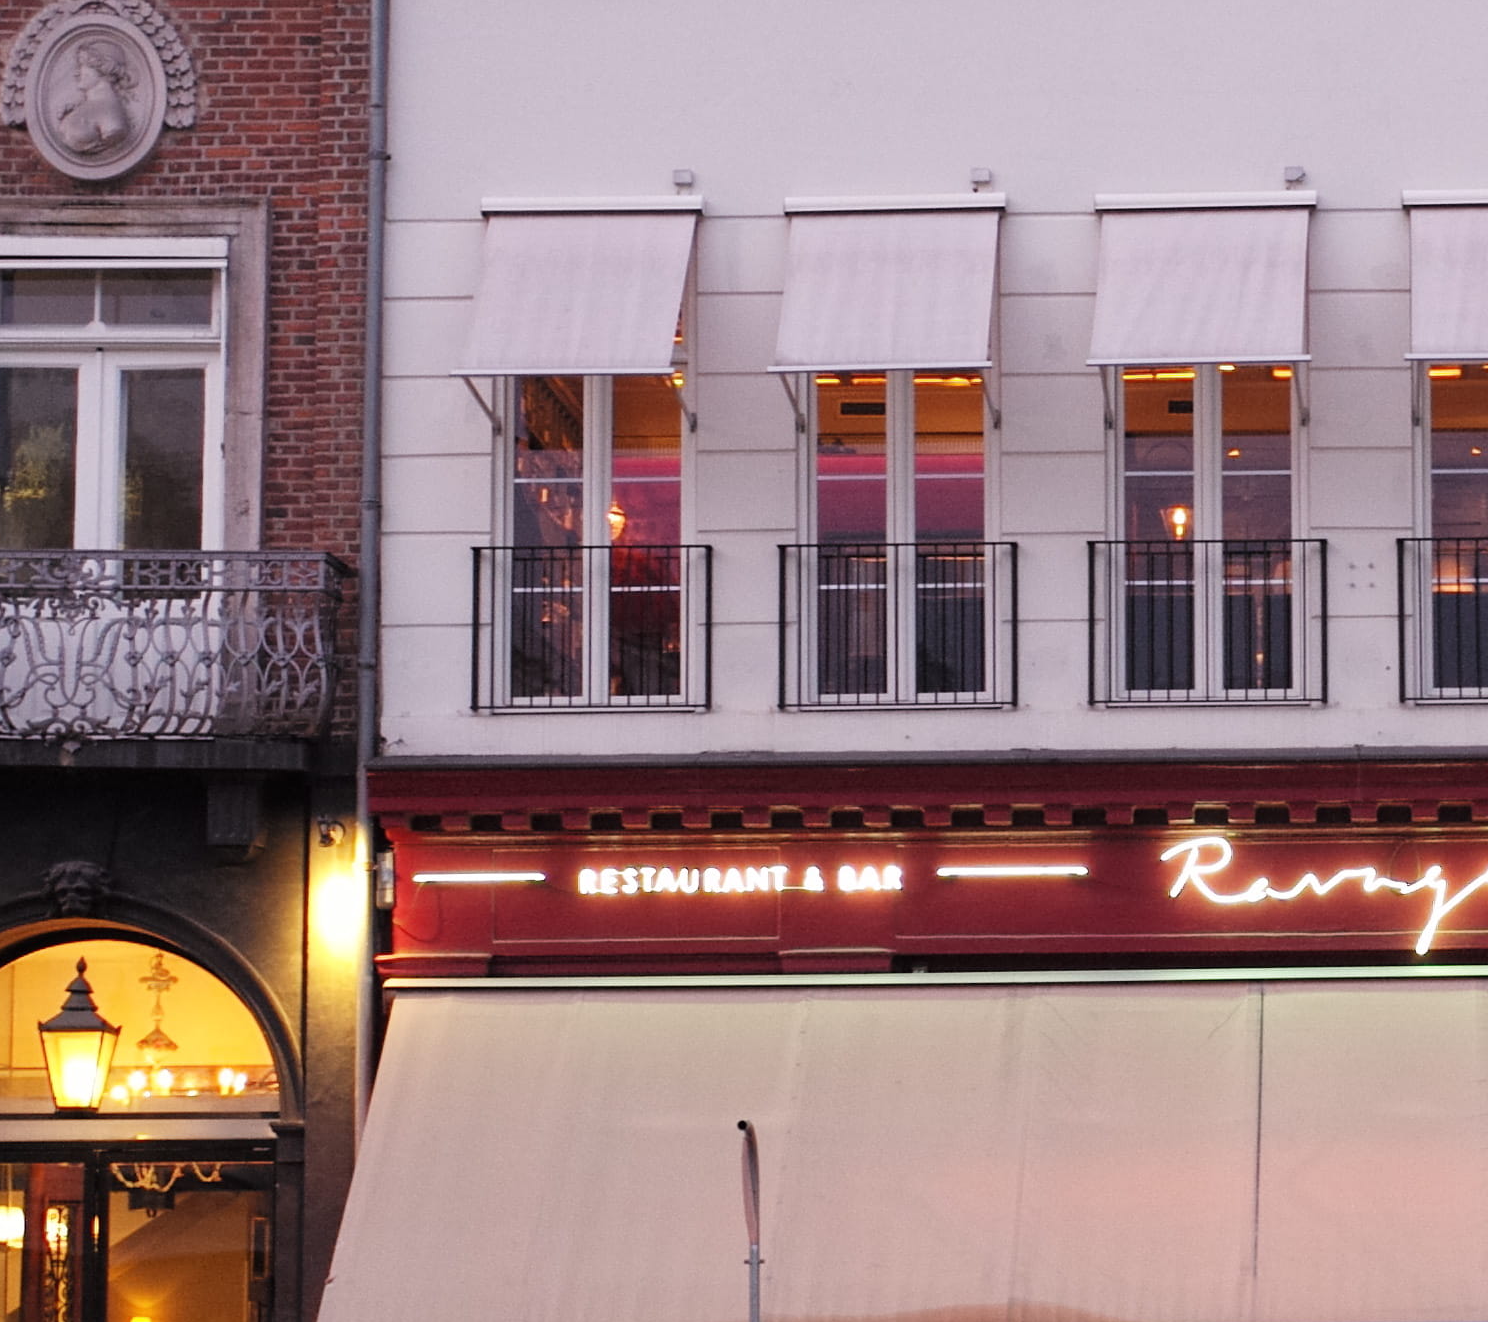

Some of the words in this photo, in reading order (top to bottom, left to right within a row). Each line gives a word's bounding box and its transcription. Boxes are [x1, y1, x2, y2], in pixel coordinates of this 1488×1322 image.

[577, 865, 789, 895] RESTAURANT
[803, 865, 825, 893] &
[836, 863, 903, 893] BAR
